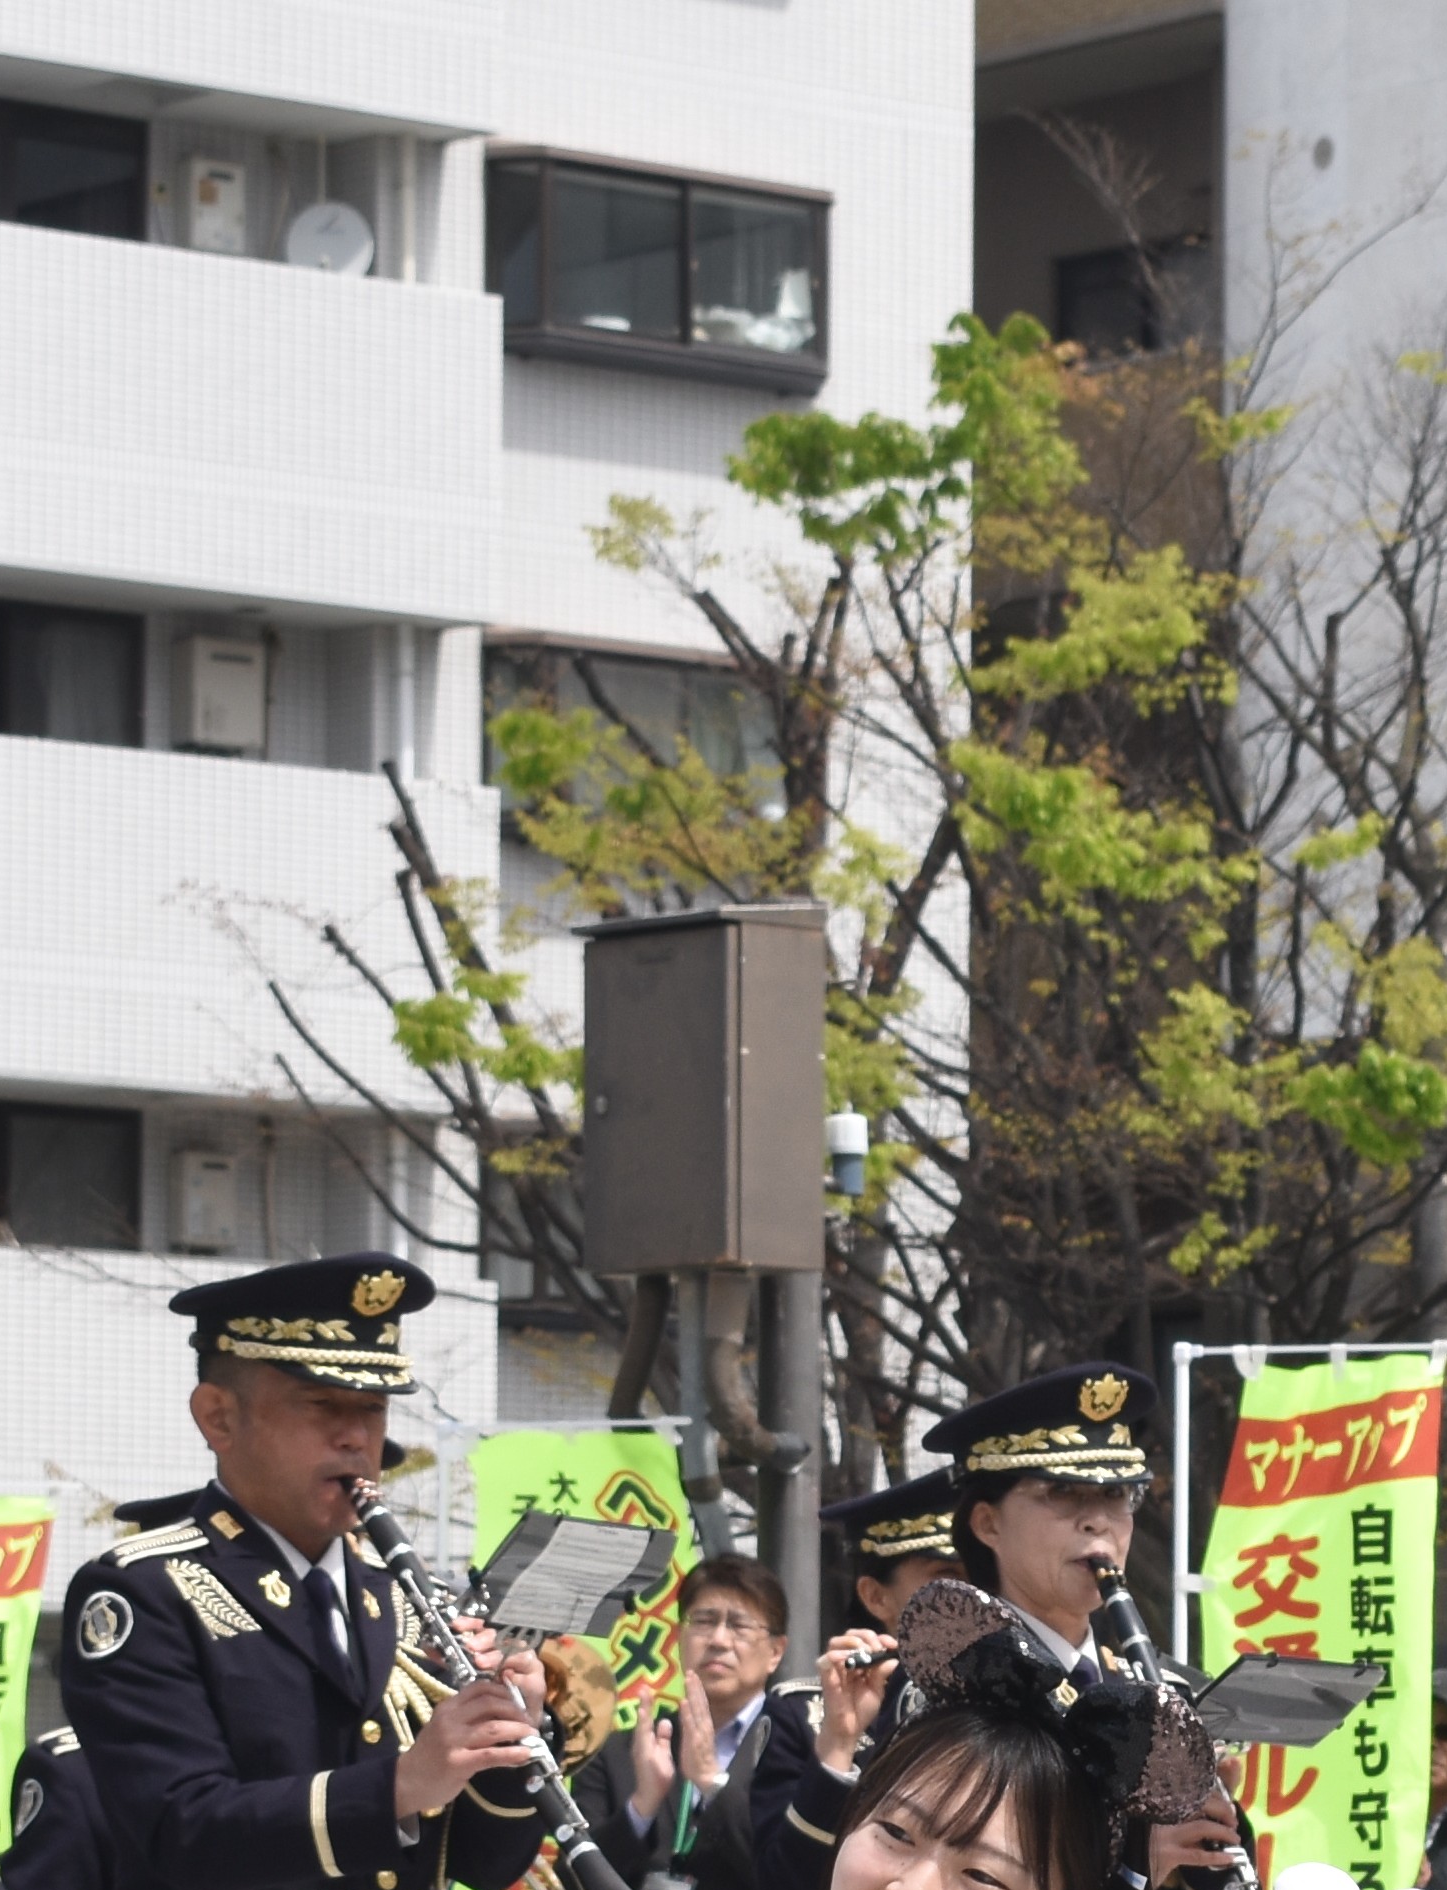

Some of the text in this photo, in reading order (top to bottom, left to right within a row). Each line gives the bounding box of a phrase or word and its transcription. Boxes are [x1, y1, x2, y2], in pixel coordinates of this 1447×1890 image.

[1244, 1393, 1429, 1498] マナーアップ
